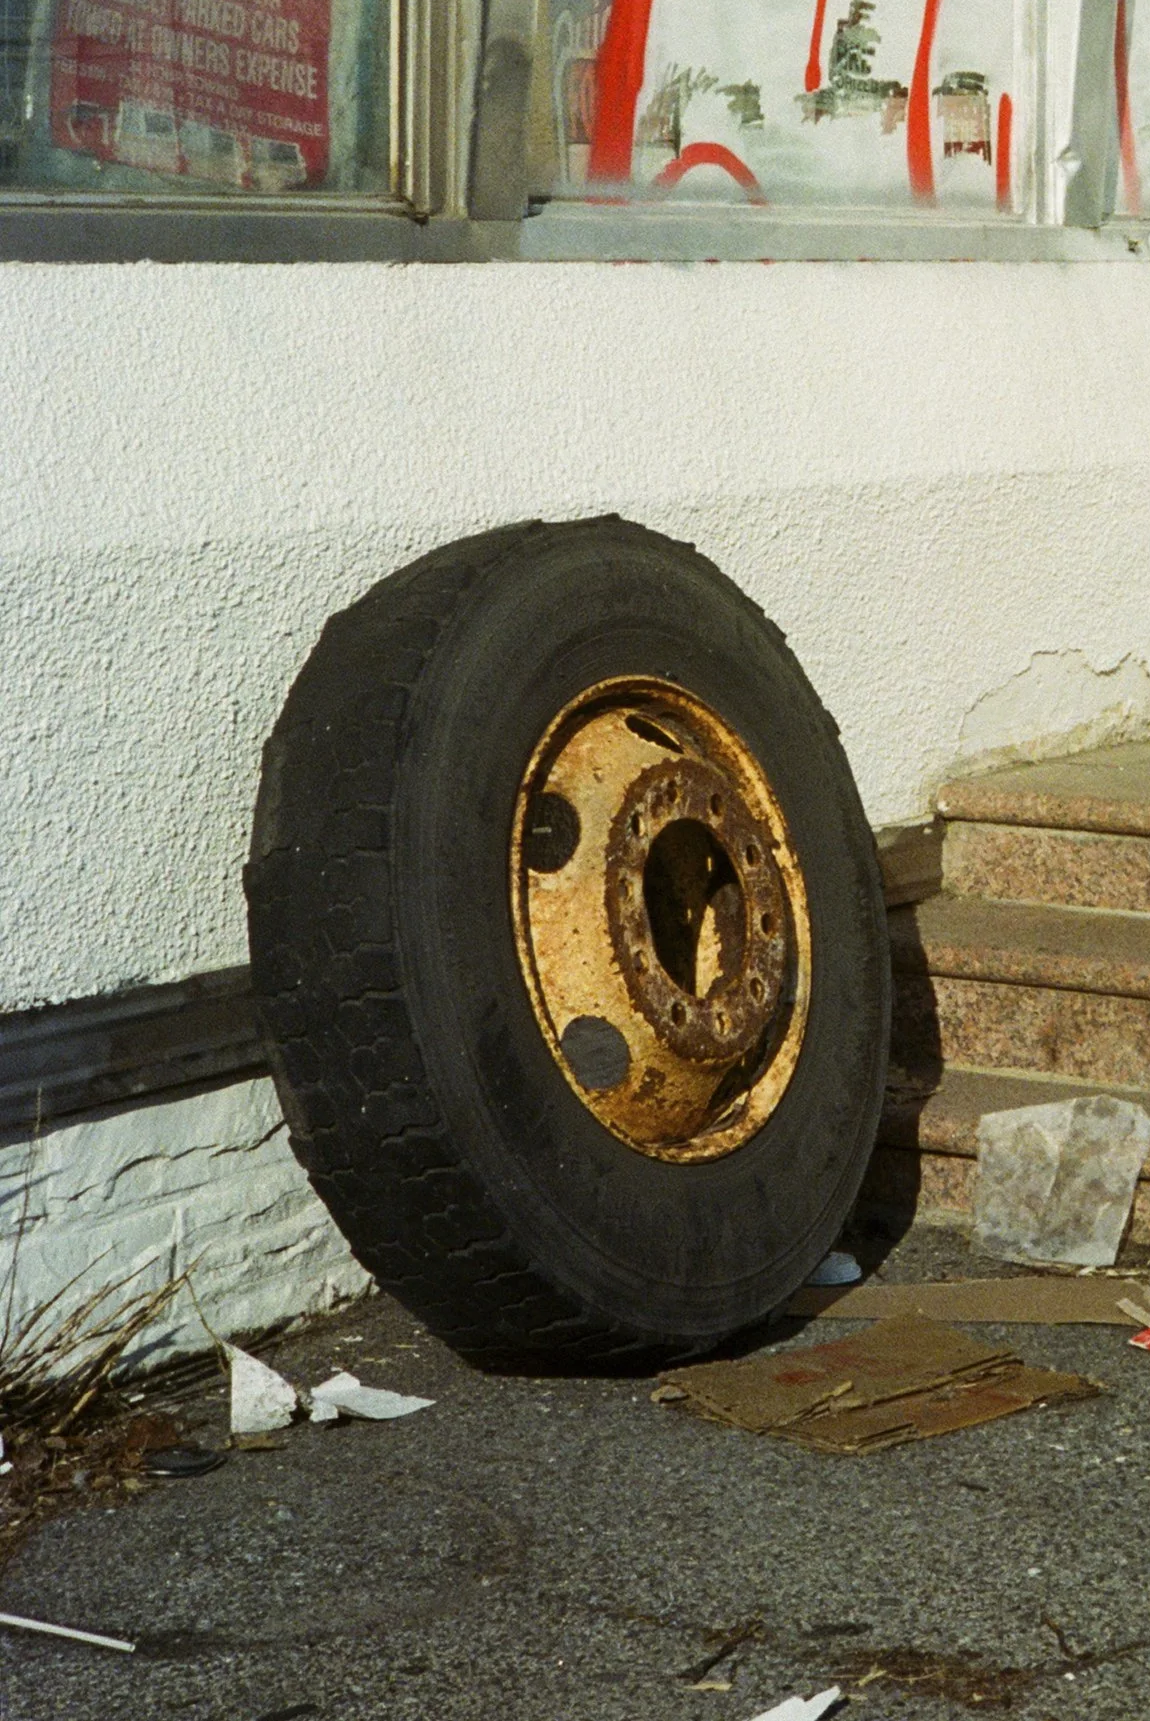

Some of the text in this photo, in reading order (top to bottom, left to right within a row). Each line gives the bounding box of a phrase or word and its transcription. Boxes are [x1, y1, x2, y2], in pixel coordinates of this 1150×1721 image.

[250, 10, 300, 54] CARS
[149, 25, 231, 74] OWNERS
[235, 47, 318, 100] EXPENSE
[257, 109, 323, 137] STORAGE
